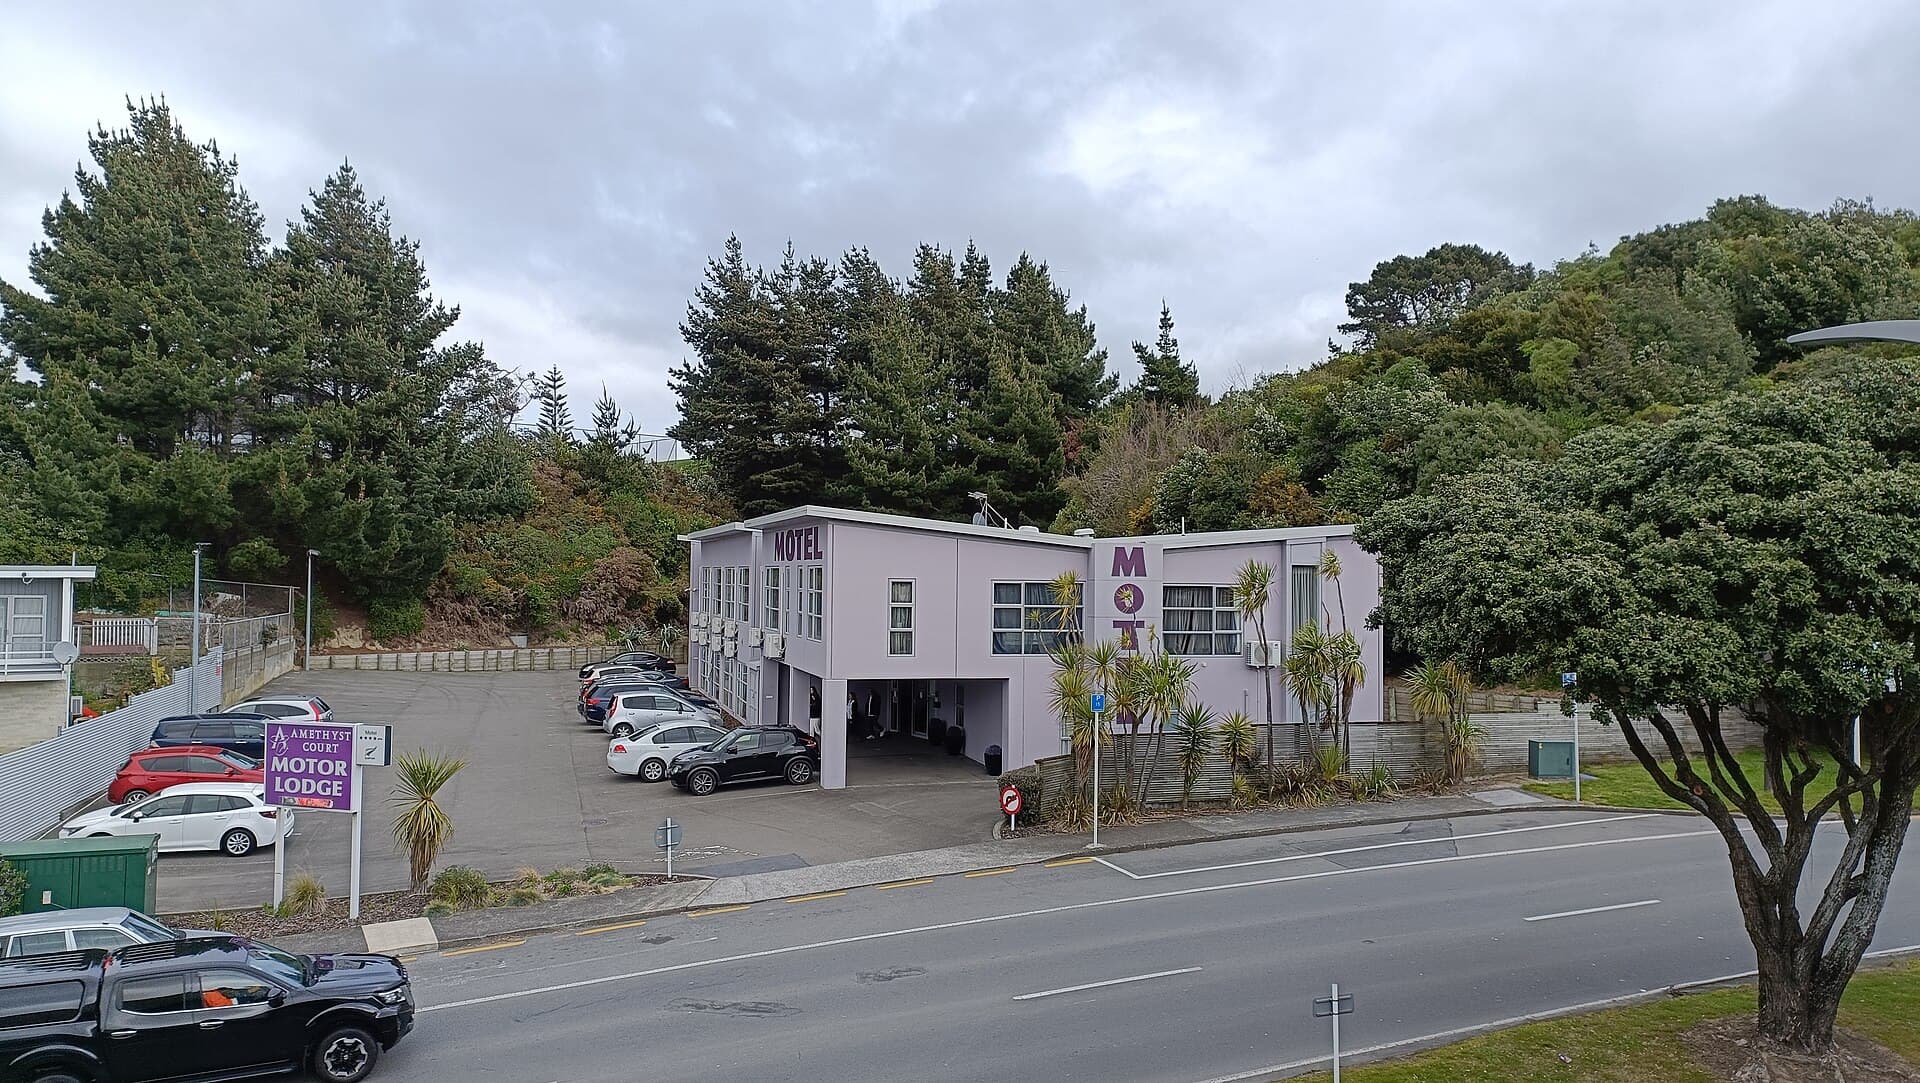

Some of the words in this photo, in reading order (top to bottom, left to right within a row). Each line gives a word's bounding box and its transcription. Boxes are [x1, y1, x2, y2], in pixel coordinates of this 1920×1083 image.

[774, 526, 823, 562] MOTEL
[1111, 546, 1147, 724] MOT
[290, 728, 351, 741] AMETHYST
[302, 742, 339, 754] COURT
[271, 756, 348, 777] MOTOR
[274, 776, 343, 797] LODGE
